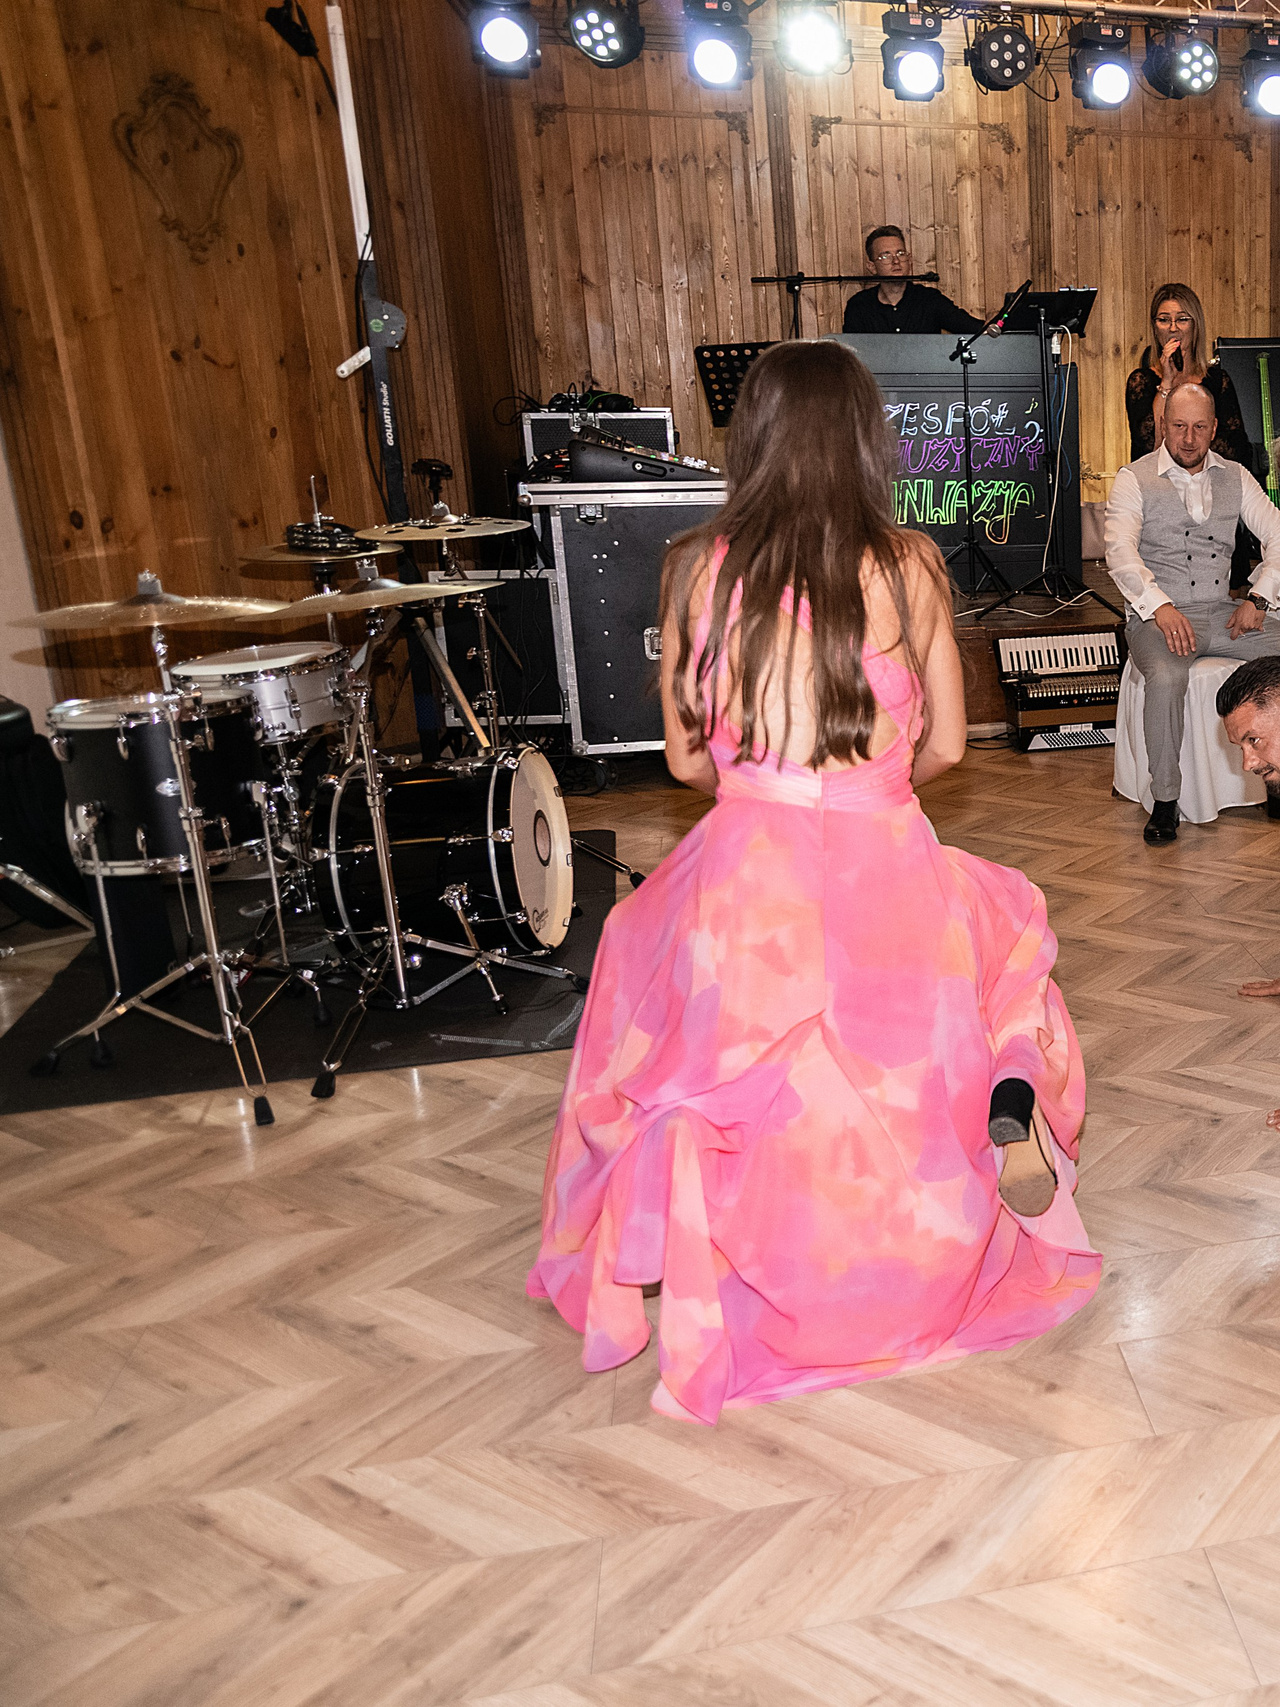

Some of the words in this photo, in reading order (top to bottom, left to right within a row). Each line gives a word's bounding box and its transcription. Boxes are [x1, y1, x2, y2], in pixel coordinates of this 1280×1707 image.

[380, 382, 390, 406] Studio
[382, 407, 395, 447] GOLIATH
[883, 398, 1016, 436] ZESPÓŁ
